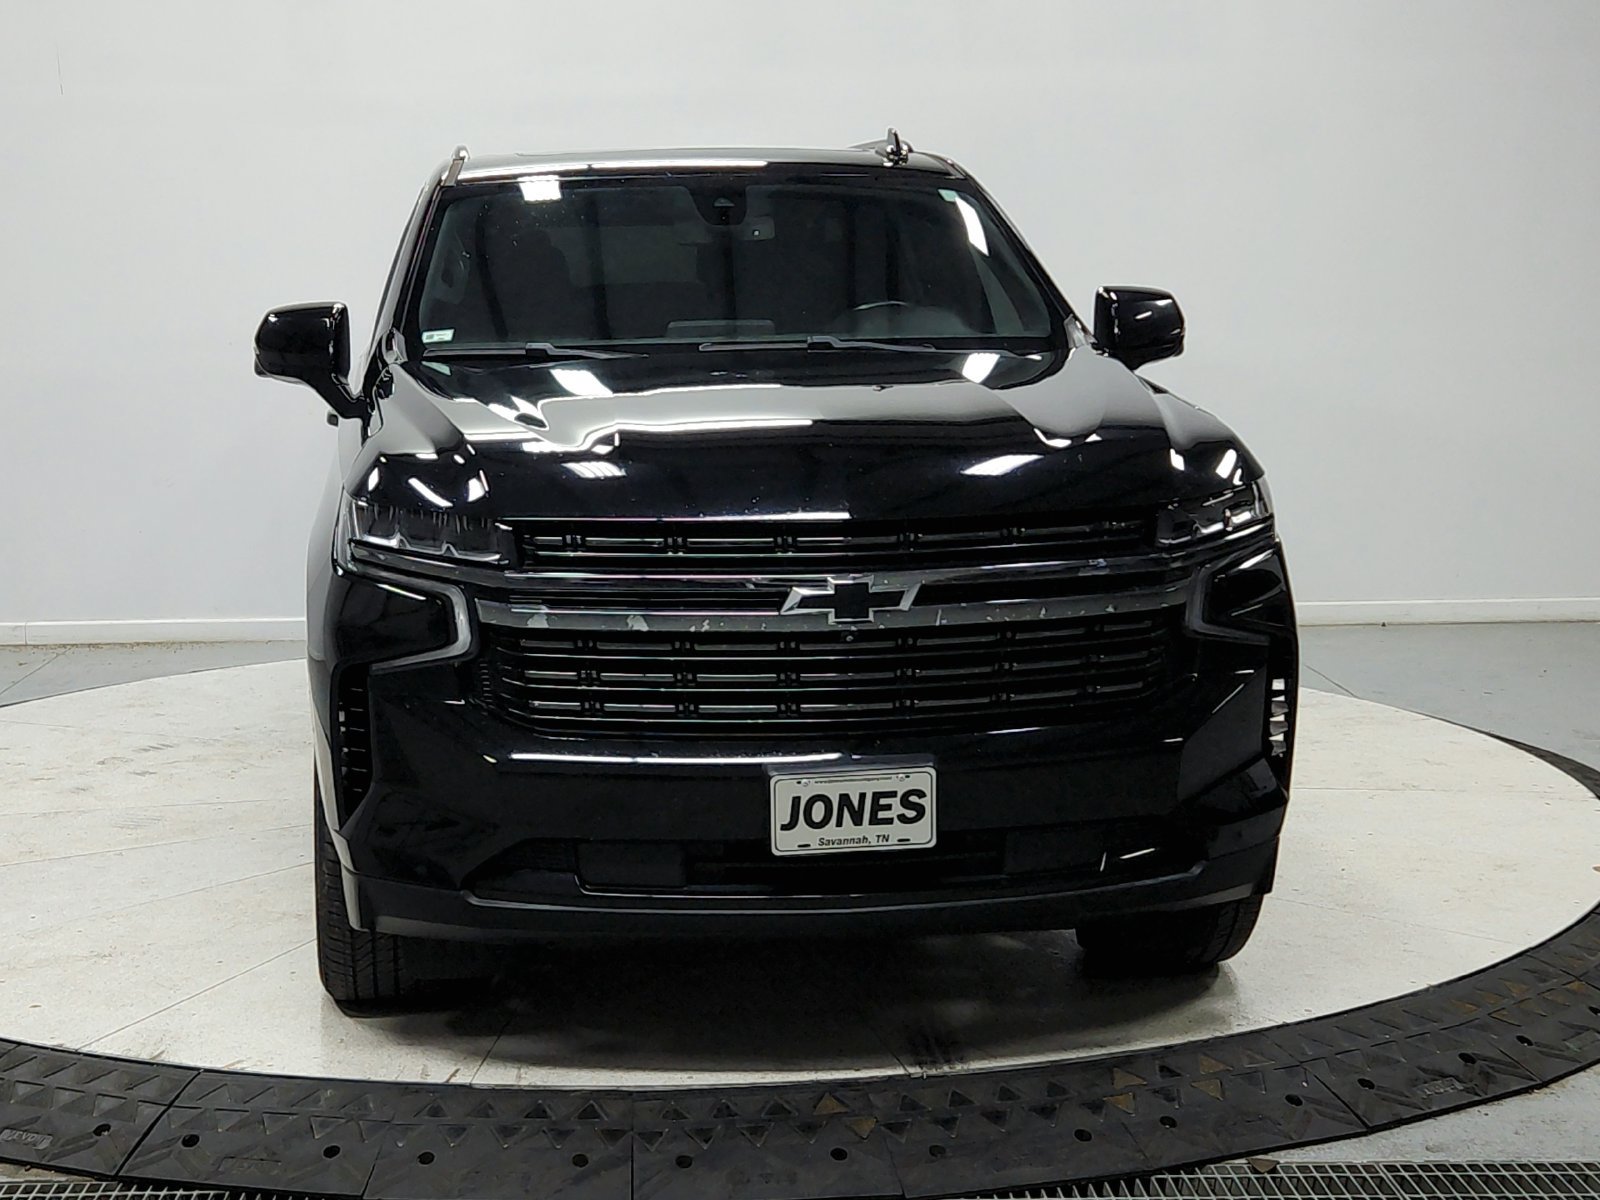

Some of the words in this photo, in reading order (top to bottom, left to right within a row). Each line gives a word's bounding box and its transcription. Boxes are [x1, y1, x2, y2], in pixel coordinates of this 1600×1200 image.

[780, 789, 927, 831] JONES
[818, 835, 871, 846] Savannah,
[875, 834, 890, 844] TN
